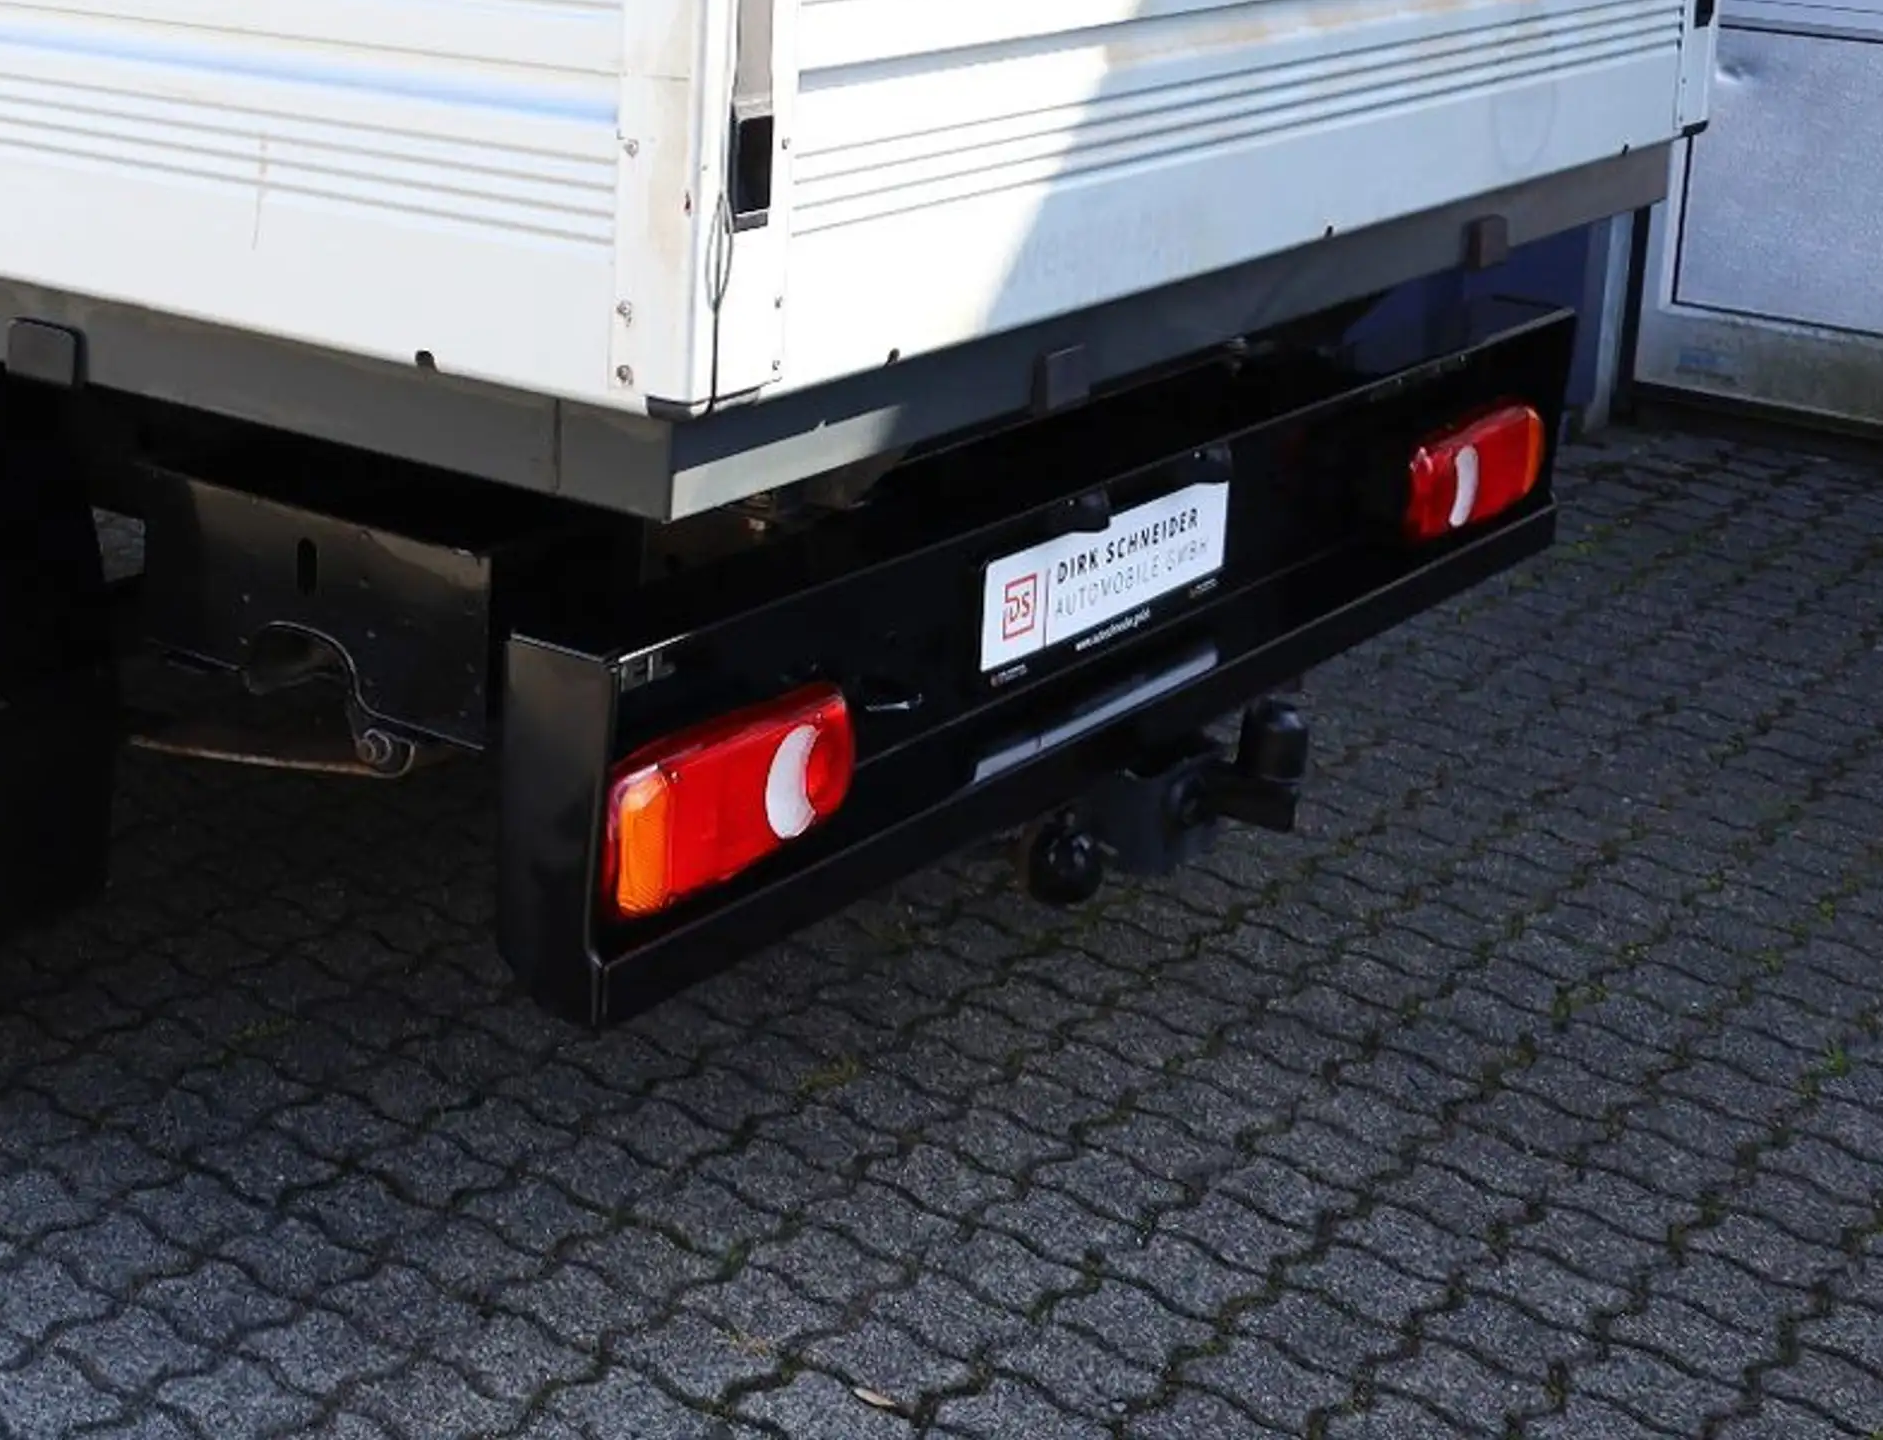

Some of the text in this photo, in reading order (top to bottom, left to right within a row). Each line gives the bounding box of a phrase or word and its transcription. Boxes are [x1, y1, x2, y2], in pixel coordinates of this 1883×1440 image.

[1057, 508, 1199, 585] DIRK SCHNEIDER
[1055, 554, 1160, 618] AUTOMOBILE
